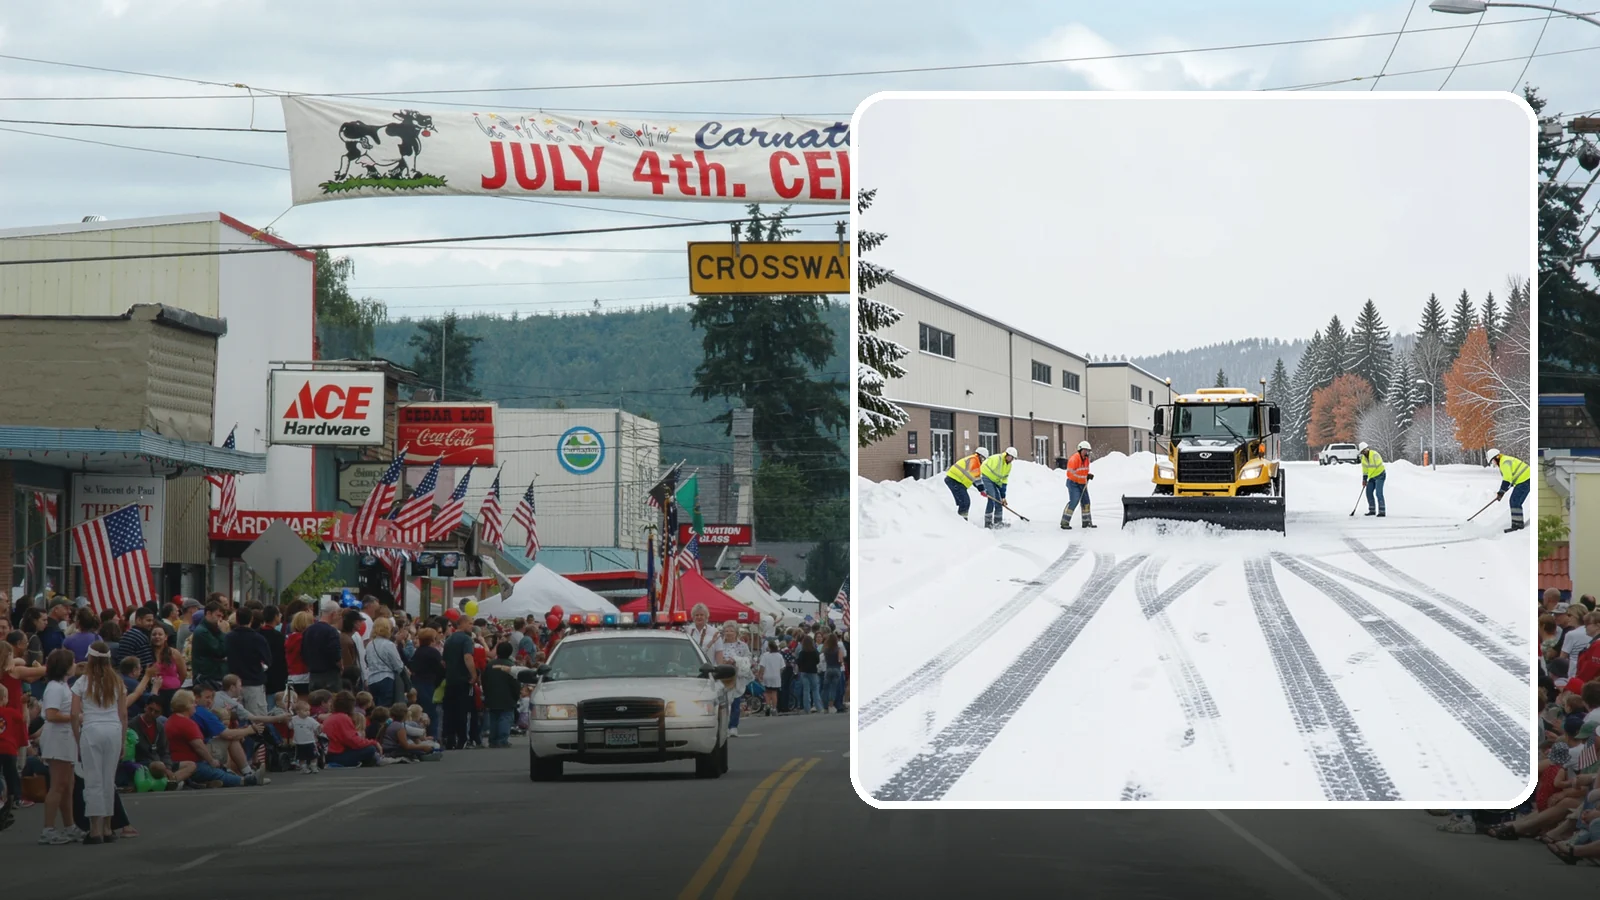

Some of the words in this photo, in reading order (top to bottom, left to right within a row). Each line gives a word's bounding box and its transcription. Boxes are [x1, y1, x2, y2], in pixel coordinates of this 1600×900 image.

[481, 141, 604, 192] JULY
[632, 150, 746, 198] 4th.
[696, 254, 850, 280] CROSSWA
[282, 380, 373, 420] ACE
[405, 409, 453, 422] CEDAR
[283, 421, 371, 436] Hardware
[416, 428, 477, 447] Coca-Cola
[83, 485, 94, 494] St.
[96, 485, 124, 495] Vincent
[126, 485, 135, 495] de
[137, 485, 155, 495] Paul
[212, 516, 331, 536] HARDARE
[688, 526, 741, 535] CRNATION
[699, 535, 730, 543] GLASS
